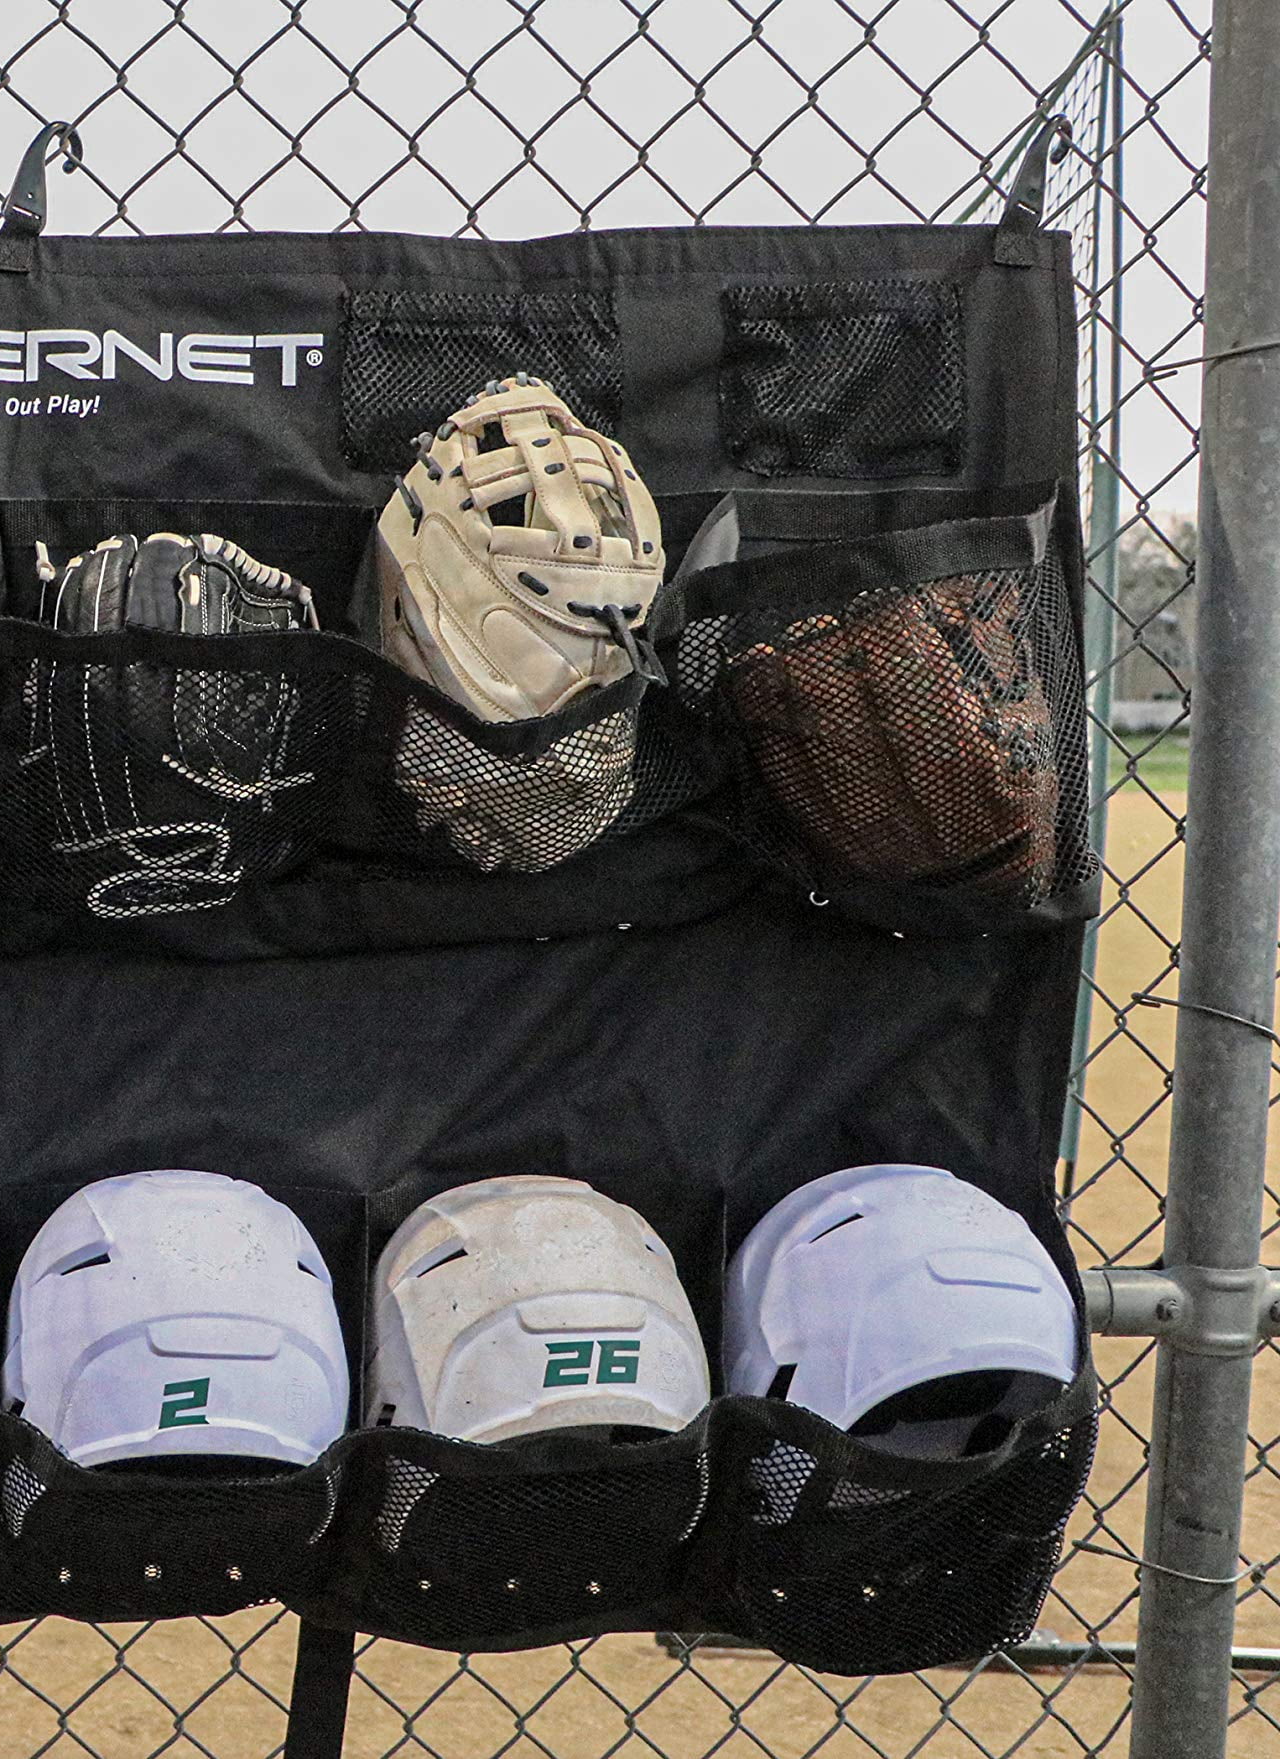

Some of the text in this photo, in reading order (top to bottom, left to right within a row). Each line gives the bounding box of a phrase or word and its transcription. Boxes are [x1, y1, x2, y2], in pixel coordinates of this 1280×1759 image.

[5, 396, 42, 417] Out
[47, 393, 101, 418] Play!
[543, 1340, 641, 1388] 26
[158, 1377, 210, 1429] 2
